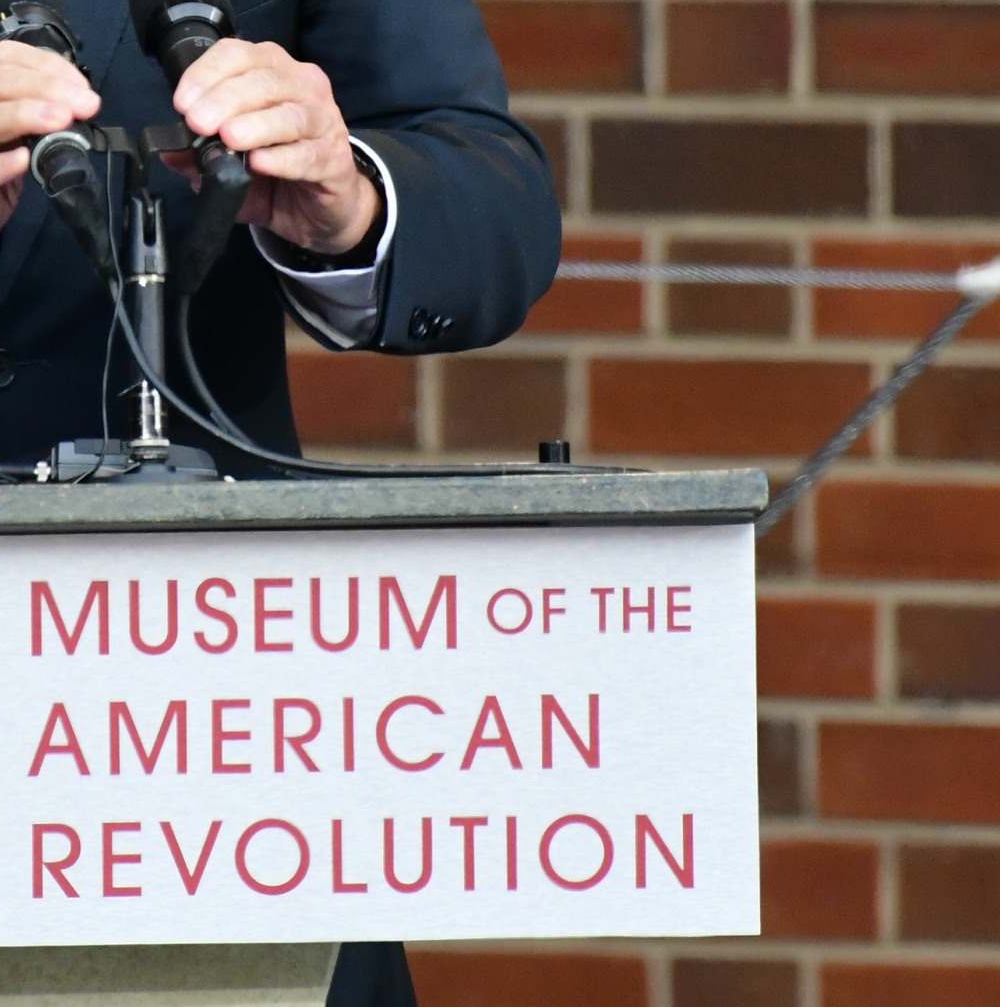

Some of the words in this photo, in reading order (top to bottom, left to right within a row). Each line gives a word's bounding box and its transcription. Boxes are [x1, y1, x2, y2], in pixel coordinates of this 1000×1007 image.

[31, 575, 457, 657] MUSEUM
[487, 588, 566, 635] OF
[591, 586, 692, 633] THE
[28, 693, 601, 777] AMERICAN
[32, 813, 695, 899] REVOLUTION
